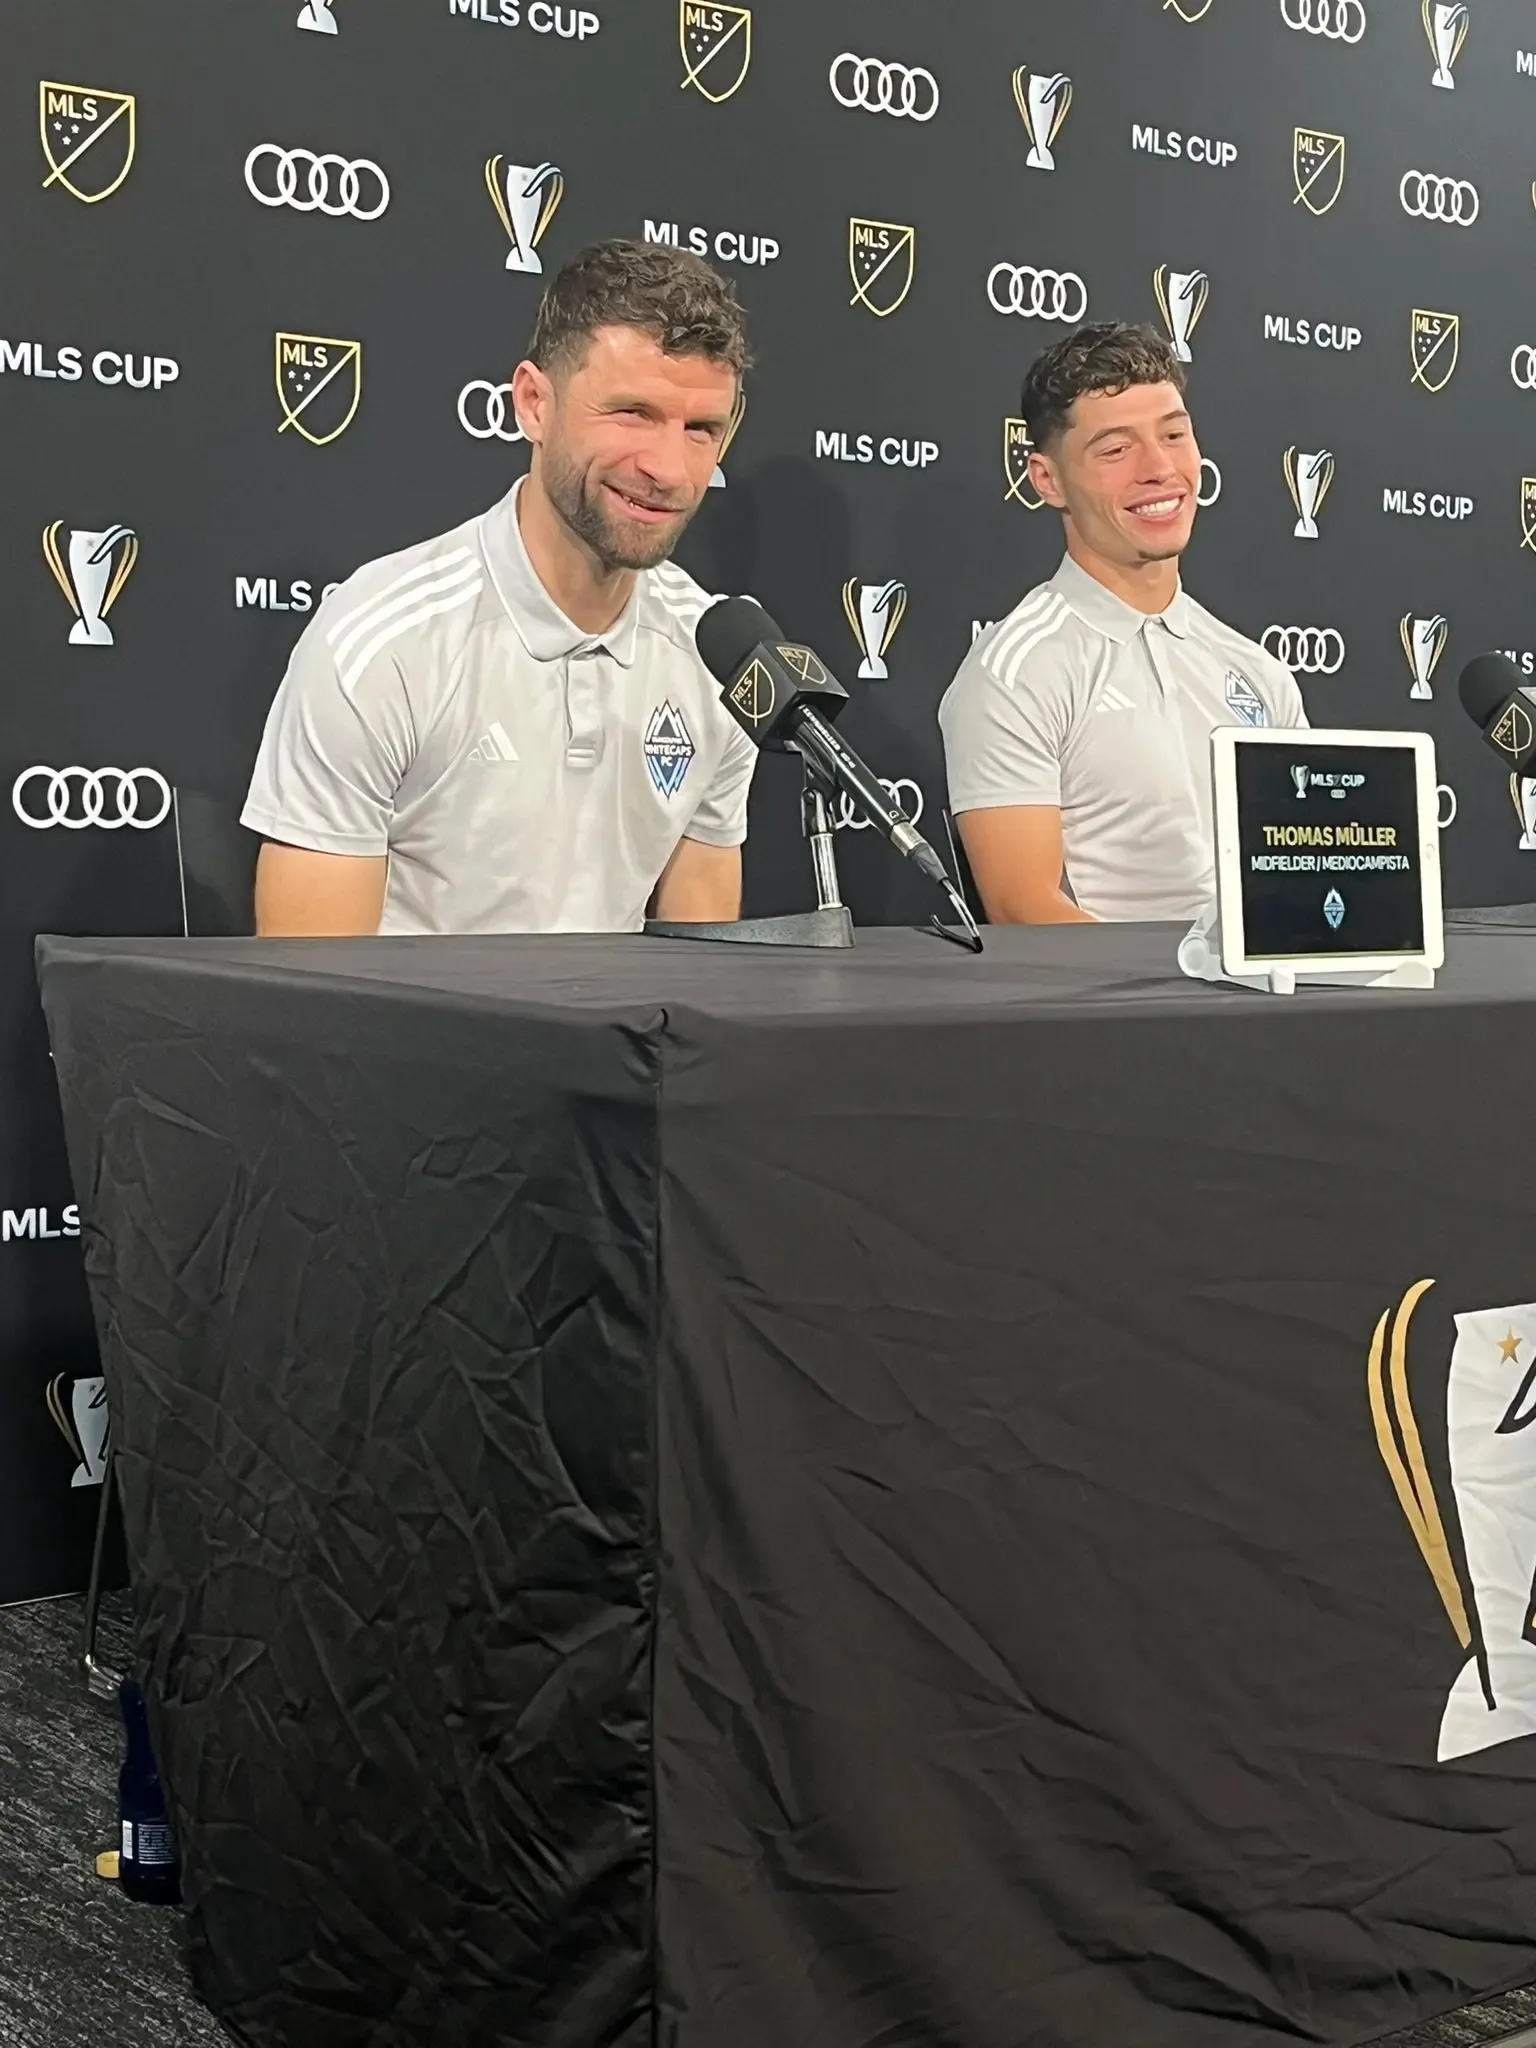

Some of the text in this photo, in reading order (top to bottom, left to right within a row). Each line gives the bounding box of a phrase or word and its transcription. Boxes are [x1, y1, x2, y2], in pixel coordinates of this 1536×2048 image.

[528, 2, 600, 41] CUP
[686, 6, 724, 32] MLS
[48, 92, 98, 121] MLS
[1132, 125, 1238, 167] MLS CUP
[1298, 134, 1326, 156] MLS
[644, 220, 780, 266] MLS CUP
[855, 226, 890, 250] MLS
[1264, 315, 1362, 351] MLS CUP
[1416, 316, 1441, 336] MLS
[0, 339, 179, 390] MLS CUP
[283, 342, 329, 368] MLS
[815, 430, 939, 468] MLS CUP
[1010, 425, 1035, 446] ML
[1383, 489, 1474, 520] MLS CUP
[235, 576, 313, 612] MLS
[734, 676, 753, 702] MLS
[1310, 773, 1365, 787] MLS CUP
[1262, 821, 1397, 847] THOMAS MÜLLER
[1251, 855, 1316, 871] MIDFIELDER
[1322, 855, 1410, 871] MEDIOCAMPISTA
[2, 1204, 81, 1242] MLS
